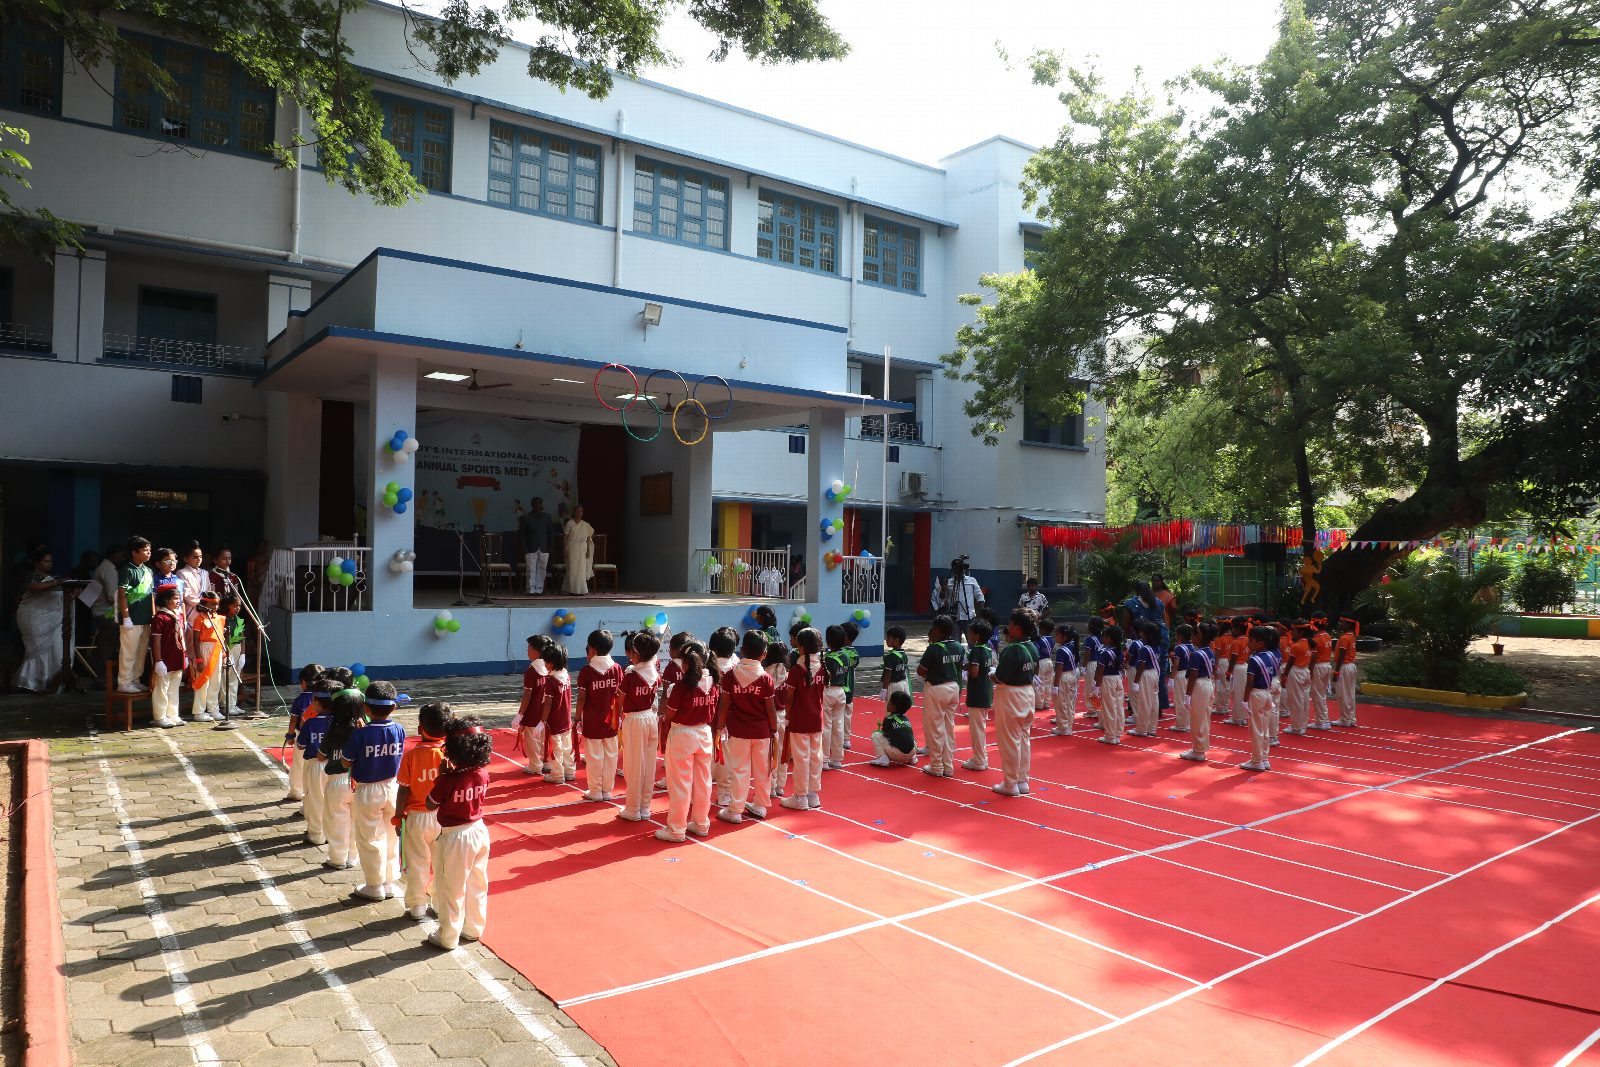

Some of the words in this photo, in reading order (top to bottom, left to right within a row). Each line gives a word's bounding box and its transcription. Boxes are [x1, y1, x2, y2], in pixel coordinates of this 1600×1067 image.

[441, 447, 529, 461] INTERNATIONAL
[531, 454, 570, 463] SCHOOL
[416, 461, 458, 473] ANNUAL
[461, 463, 501, 475] SPORTS
[504, 466, 529, 476] MEET
[592, 678, 617, 691] HOPE
[635, 685, 657, 696] HO
[692, 694, 715, 707] HOPE
[365, 742, 403, 758] PEACE
